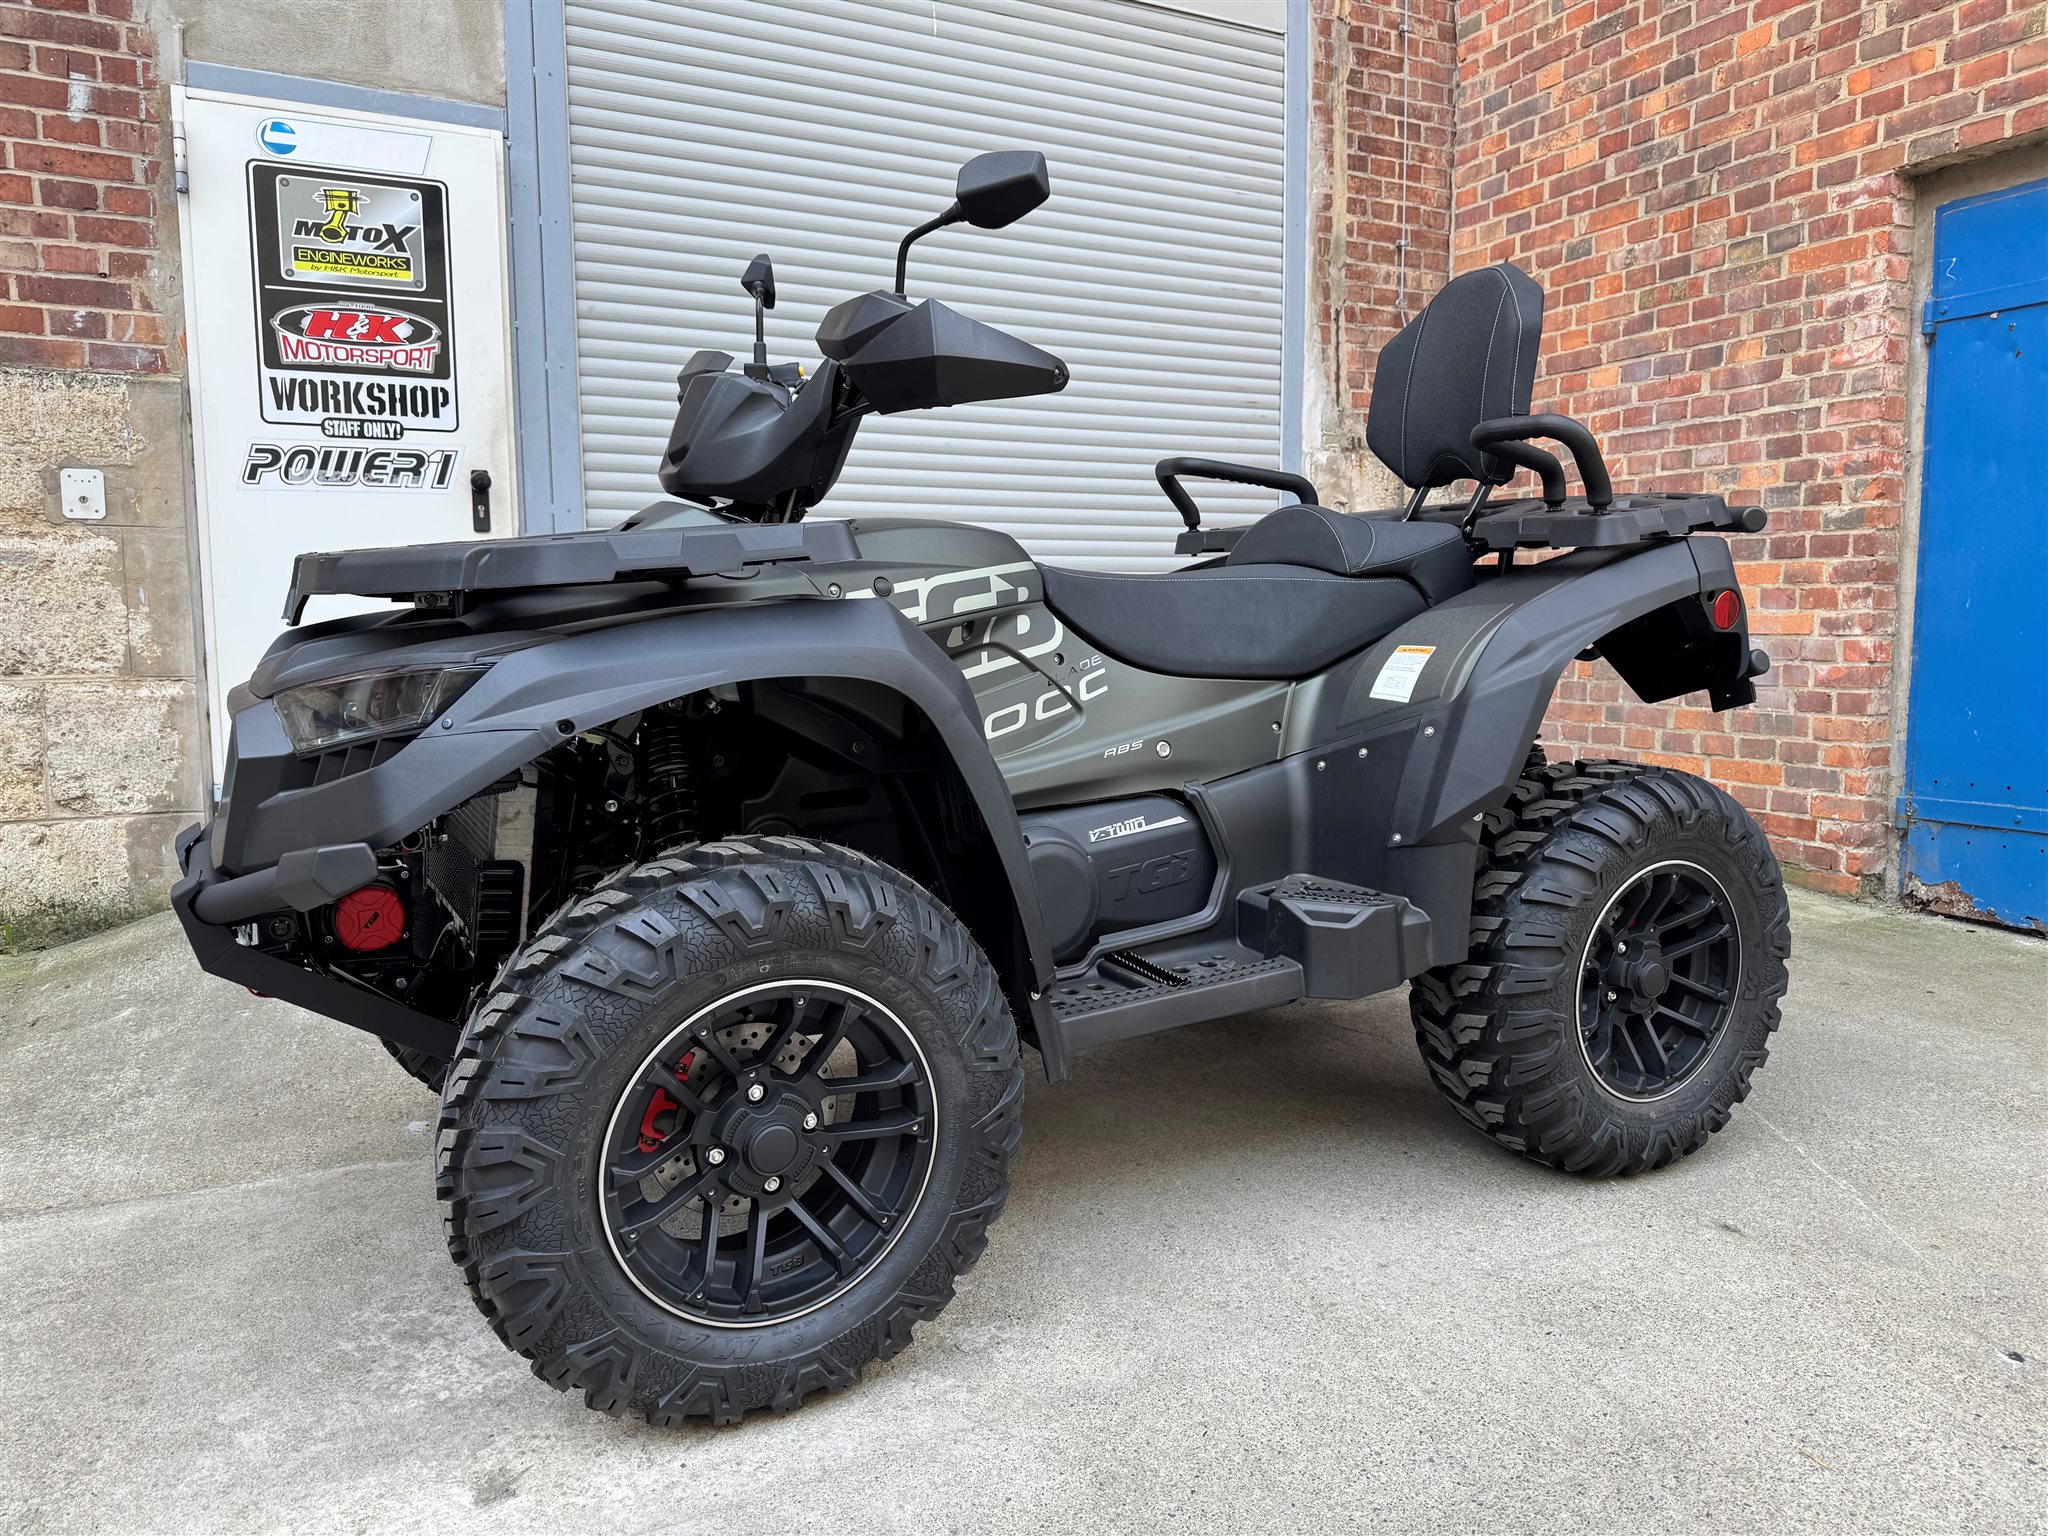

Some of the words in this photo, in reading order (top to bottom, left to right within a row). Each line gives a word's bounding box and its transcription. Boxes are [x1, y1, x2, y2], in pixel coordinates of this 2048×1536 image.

[298, 249, 407, 269] ENGINEWORKS
[324, 265, 348, 273] H&K
[350, 267, 399, 278] Motorsport
[304, 309, 410, 345] H&K
[281, 335, 438, 369] MOTORSPORT
[269, 376, 449, 419] WORKSHOP
[324, 420, 360, 437] STAFF
[363, 422, 401, 439] ONLY!
[1103, 739, 1144, 759] ABS
[1108, 849, 1198, 902] TGB
[363, 911, 380, 930] TGB
[770, 1254, 805, 1277] TGB
